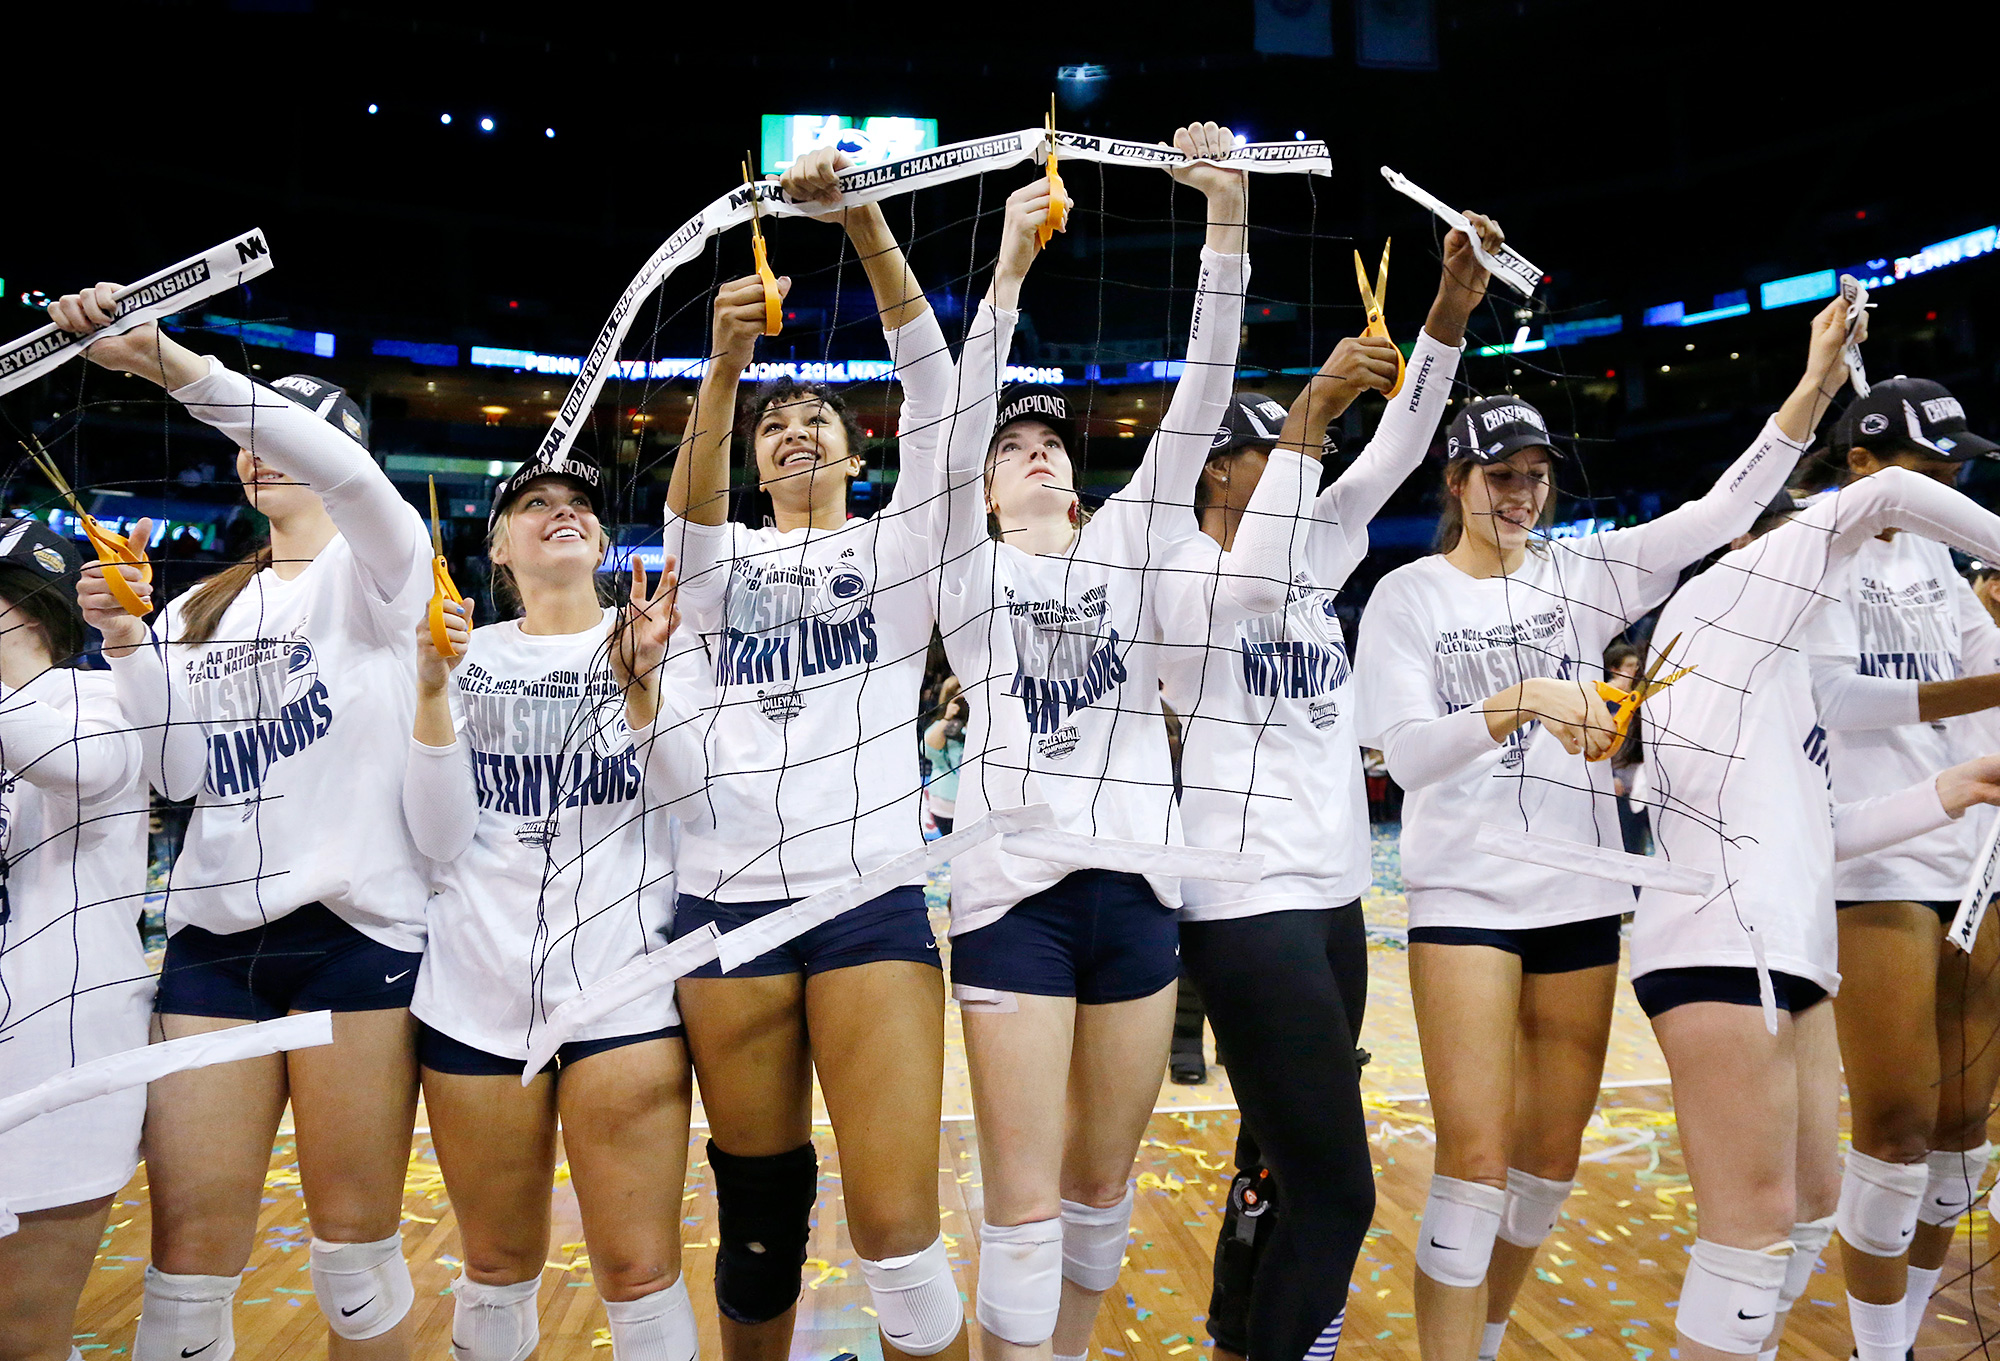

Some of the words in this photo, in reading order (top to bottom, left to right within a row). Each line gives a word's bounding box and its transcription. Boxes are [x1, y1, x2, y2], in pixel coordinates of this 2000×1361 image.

[900, 136, 1021, 177] CHAMPIONSHIP
[1112, 144, 1186, 162] VOLLEYB
[563, 325, 616, 423] VOLLEYBALL
[612, 213, 705, 324] CHAMPIONSHIP
[1191, 306, 1203, 341] PENN
[525, 354, 580, 376] PENN
[800, 362, 848, 380] 2014
[1409, 384, 1424, 413] PENN
[1417, 354, 1434, 386] STATE
[512, 459, 600, 491] CHAMIONS
[1729, 469, 1748, 493] PENN
[1747, 441, 1772, 471] STATE
[765, 571, 817, 587] NATIONAL
[801, 607, 879, 677] LIONS
[224, 651, 278, 676] NATIONAL
[466, 662, 493, 685] 2014
[523, 683, 580, 699] NATIONAL
